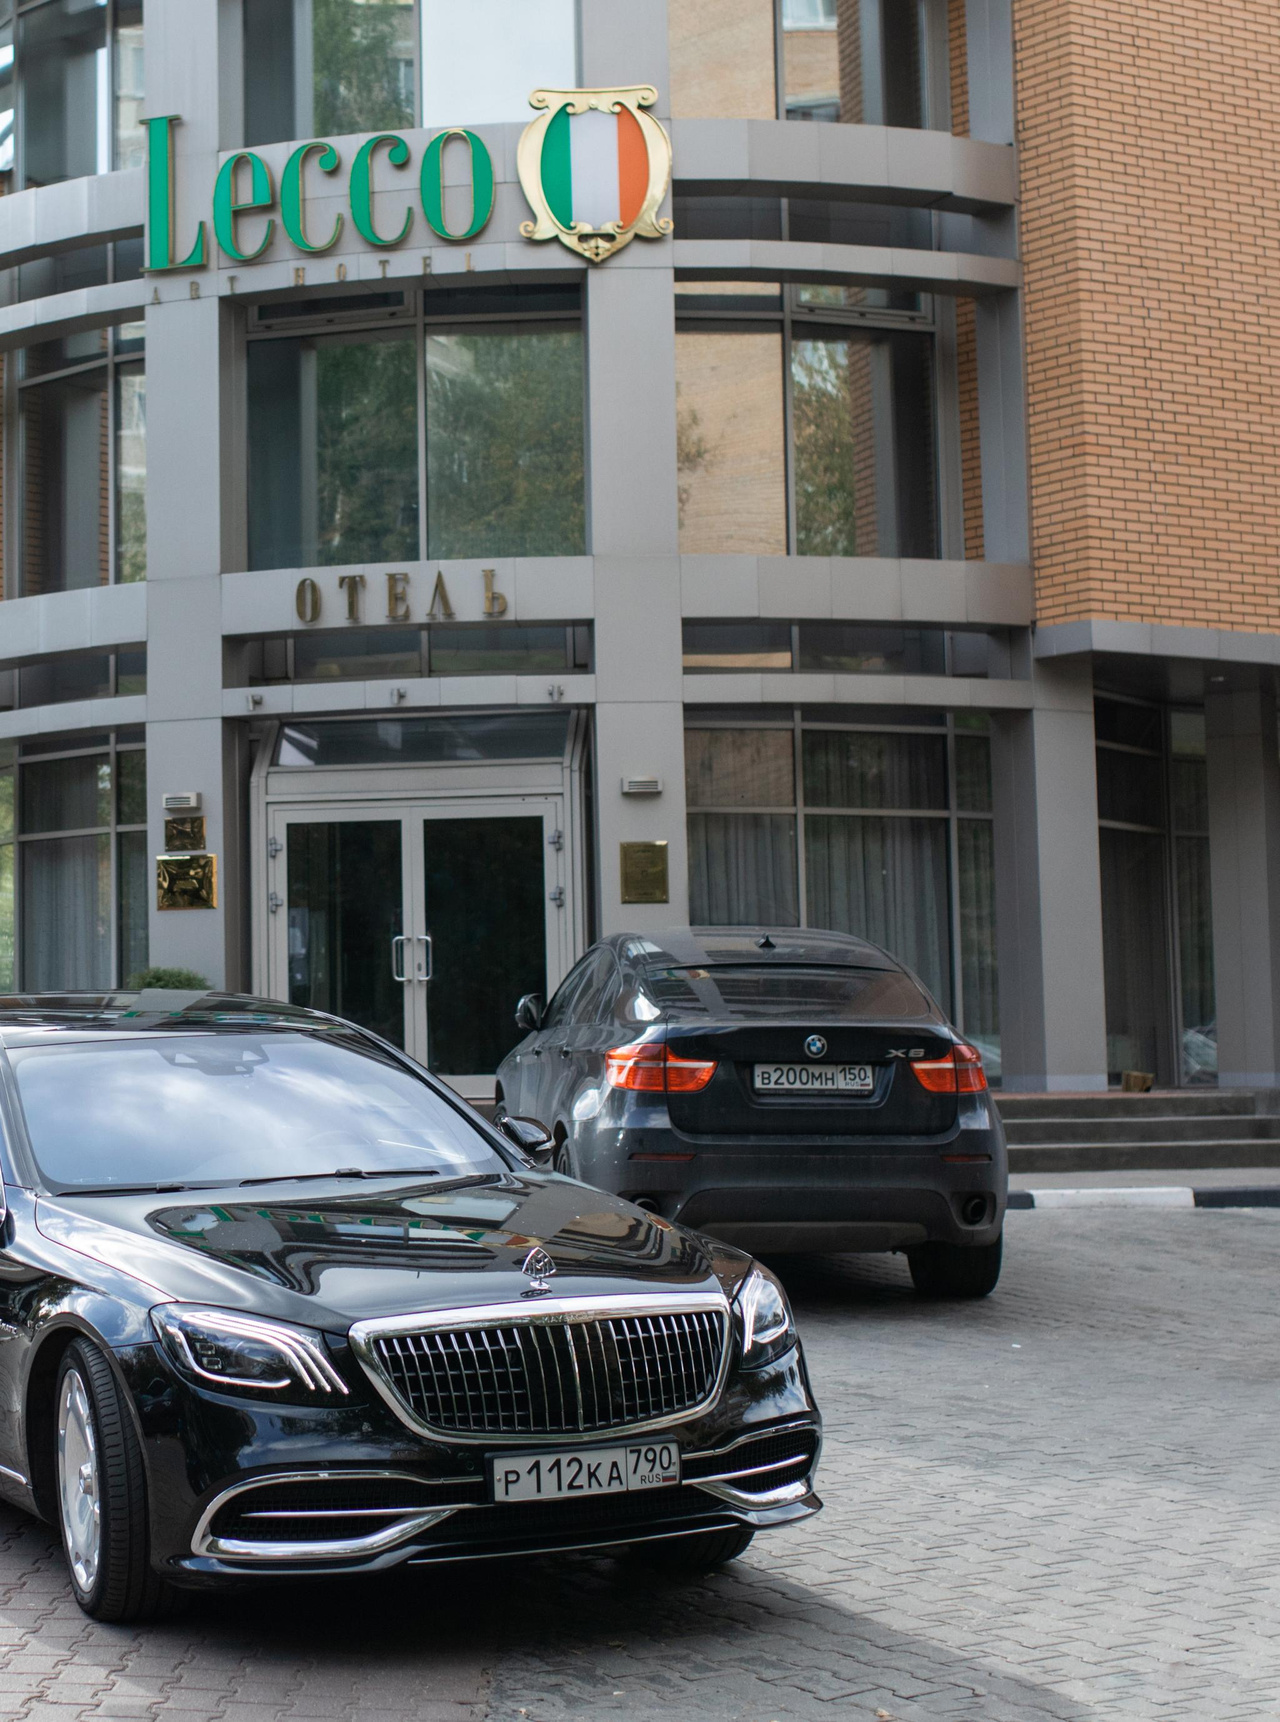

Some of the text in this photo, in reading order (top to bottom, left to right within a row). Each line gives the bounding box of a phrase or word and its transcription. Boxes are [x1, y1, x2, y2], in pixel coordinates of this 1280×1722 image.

[140, 114, 495, 272] Lecco
[152, 252, 475, 305] ART HOTEL
[295, 569, 508, 623] ОТЕЛЬ
[885, 1048, 926, 1058] X6
[629, 1445, 672, 1475] 790
[640, 1474, 662, 1485] RUS
